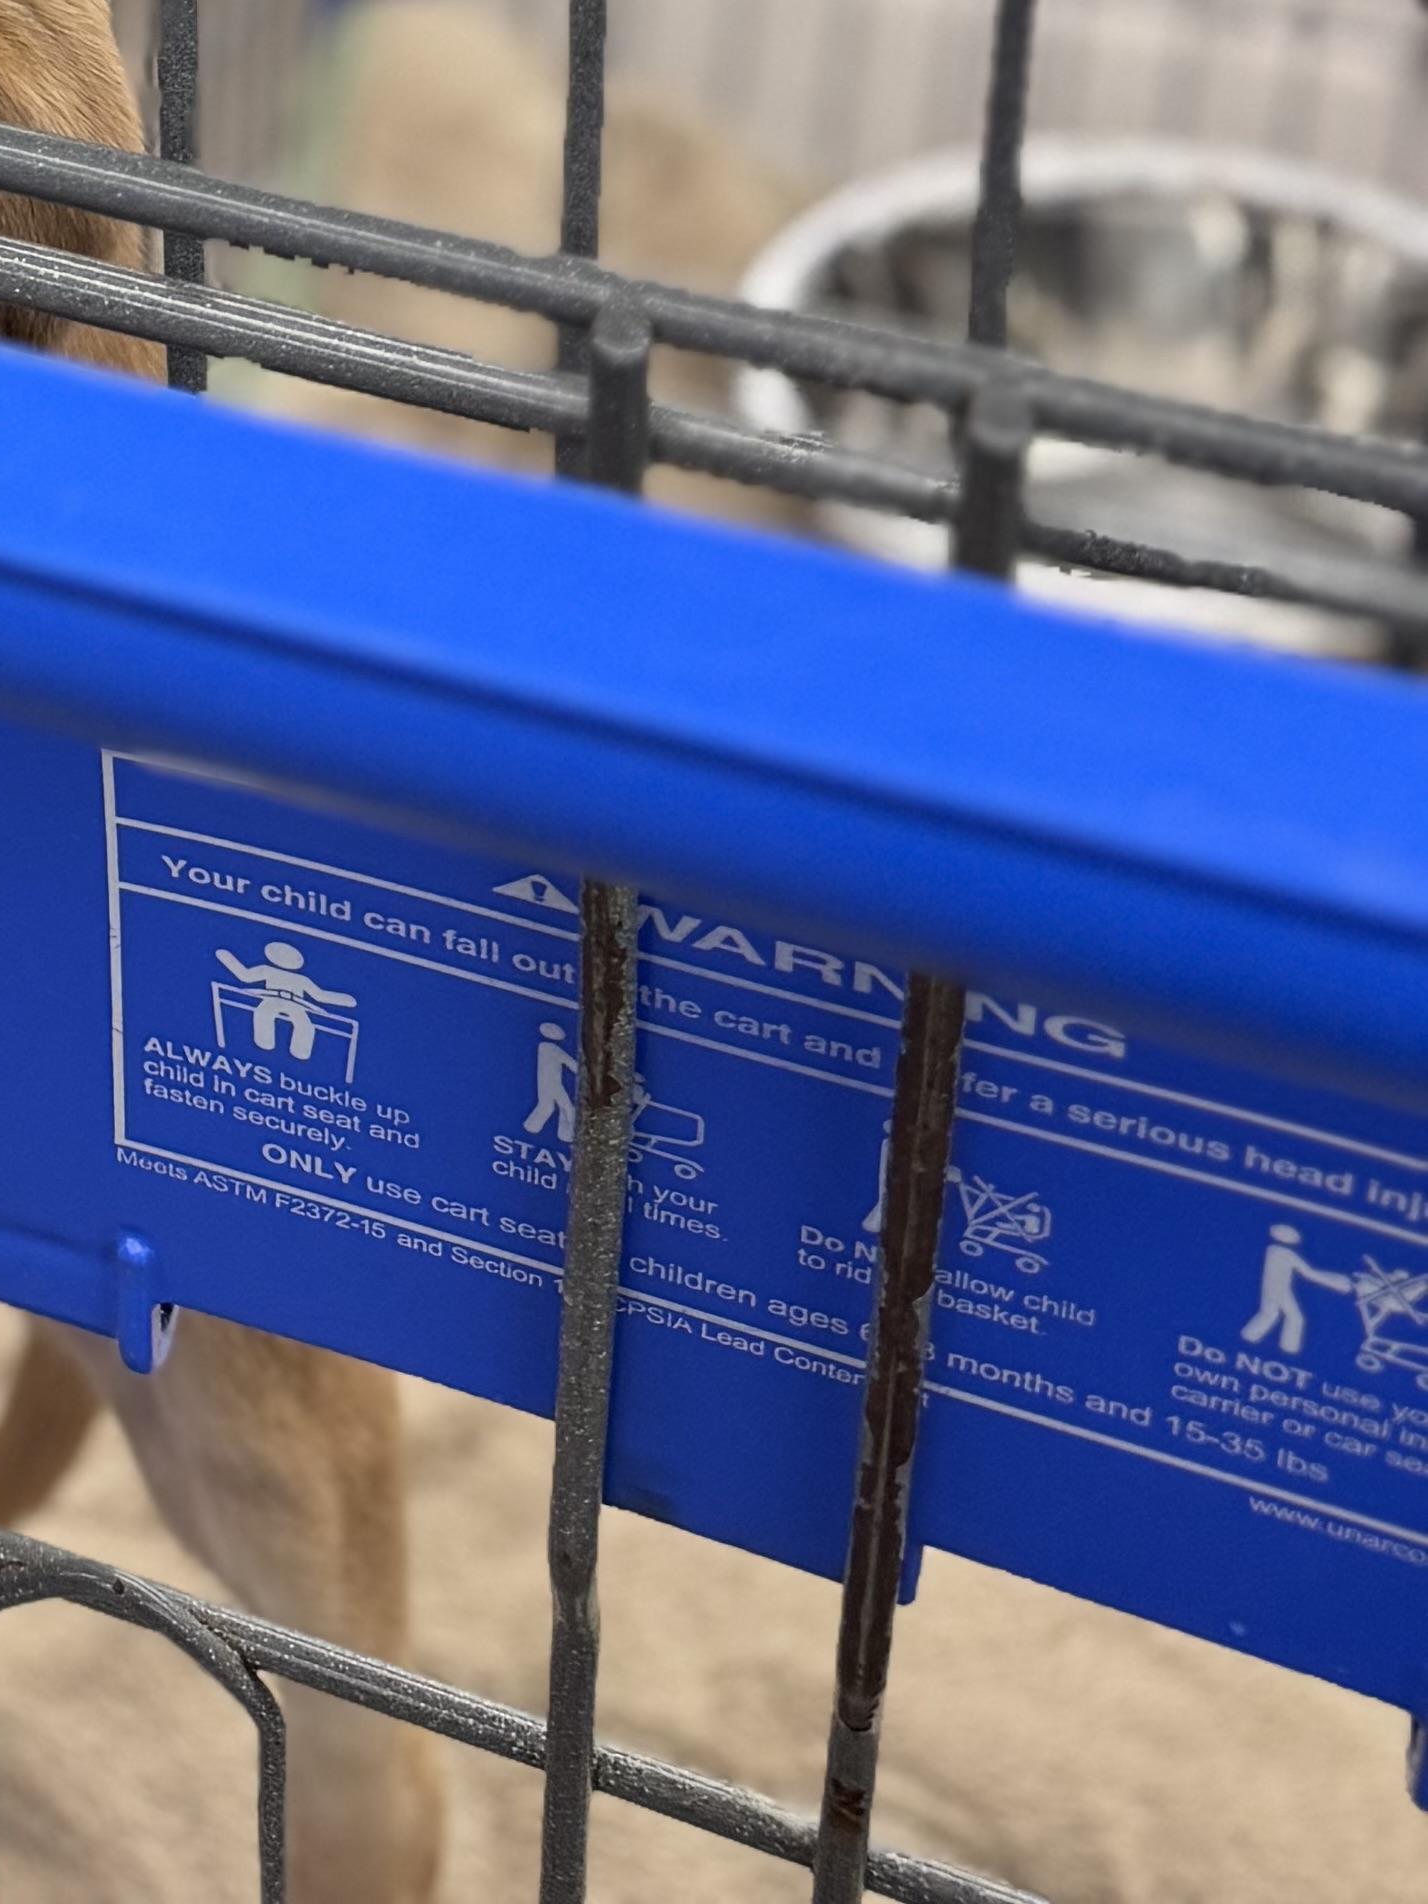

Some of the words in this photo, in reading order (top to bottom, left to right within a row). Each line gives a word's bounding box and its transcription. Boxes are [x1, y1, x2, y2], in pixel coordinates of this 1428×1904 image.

[637, 903, 1127, 1059] WARNNG
[161, 854, 249, 894] Your
[261, 882, 352, 922] child
[363, 911, 432, 944] can
[443, 928, 499, 963] fall
[512, 950, 576, 985] out
[638, 984, 702, 1019] the
[714, 1008, 792, 1045] cart
[804, 1031, 882, 1069] and
[1029, 1094, 1054, 1115] a
[1067, 1101, 1230, 1161] serious
[1244, 1144, 1353, 1195] head
[1367, 1178, 1428, 1222] inj
[144, 1037, 272, 1085] ALWAYS
[280, 1071, 368, 1113] buckle
[377, 1103, 411, 1126] up
[144, 1059, 205, 1088] child
[213, 1077, 237, 1097] in
[243, 1088, 296, 1114] cart
[302, 1101, 361, 1133] seat
[369, 1124, 420, 1150] and
[144, 1078, 225, 1115] fasten
[232, 1105, 352, 1151] securely.
[492, 1159, 558, 1190] child
[653, 1184, 719, 1216] your
[493, 1135, 572, 1173] STAY
[643, 1201, 729, 1242] times.
[800, 1225, 845, 1253] Do
[193, 1168, 268, 1205] ASTM
[274, 1192, 387, 1240] F2372-15
[397, 1228, 444, 1258] and
[450, 1244, 544, 1289] Section
[614, 1297, 694, 1335] CPSIA
[700, 1323, 766, 1357] Lead
[797, 1249, 826, 1271] to
[835, 1260, 873, 1286] rid
[935, 1267, 1015, 1304] allow
[1024, 1293, 1096, 1327] child
[261, 1142, 357, 1185] ONLY
[365, 1176, 422, 1206] use
[430, 1194, 491, 1226] cart
[629, 1255, 758, 1308] children
[766, 1297, 850, 1336] ages
[945, 1350, 1076, 1405] months
[1084, 1390, 1153, 1427] and
[1165, 1414, 1267, 1463] 15-35
[1276, 1447, 1330, 1484] lbs
[1173, 1361, 1241, 1392] own
[1249, 1383, 1391, 1438] personal
[1177, 1335, 1227, 1364] Do
[1235, 1351, 1315, 1390] NOT
[1322, 1381, 1382, 1412] use
[1391, 1402, 1428, 1428] yo
[1171, 1383, 1275, 1425] carrier
[1281, 1418, 1316, 1438] or
[1323, 1430, 1378, 1458] car
